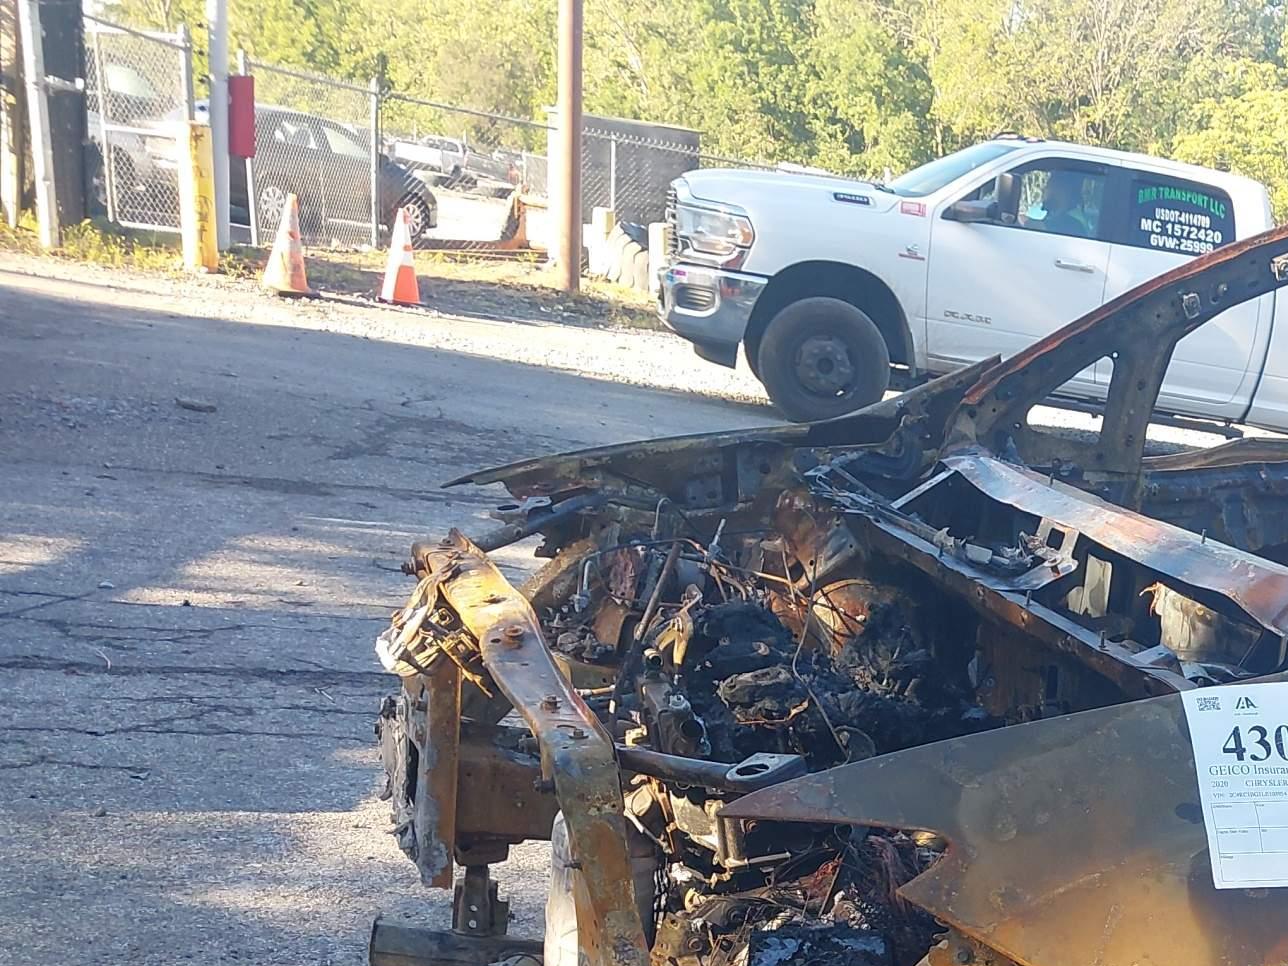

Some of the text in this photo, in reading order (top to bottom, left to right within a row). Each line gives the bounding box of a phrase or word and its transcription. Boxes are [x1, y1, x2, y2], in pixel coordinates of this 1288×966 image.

[1159, 187, 1209, 209] TRANSPORT
[1209, 197, 1226, 219] LLC
[1140, 218, 1223, 244] MC 1572420
[1208, 764, 1250, 777] GEICO
[1245, 779, 1288, 788] CHRYSLER
